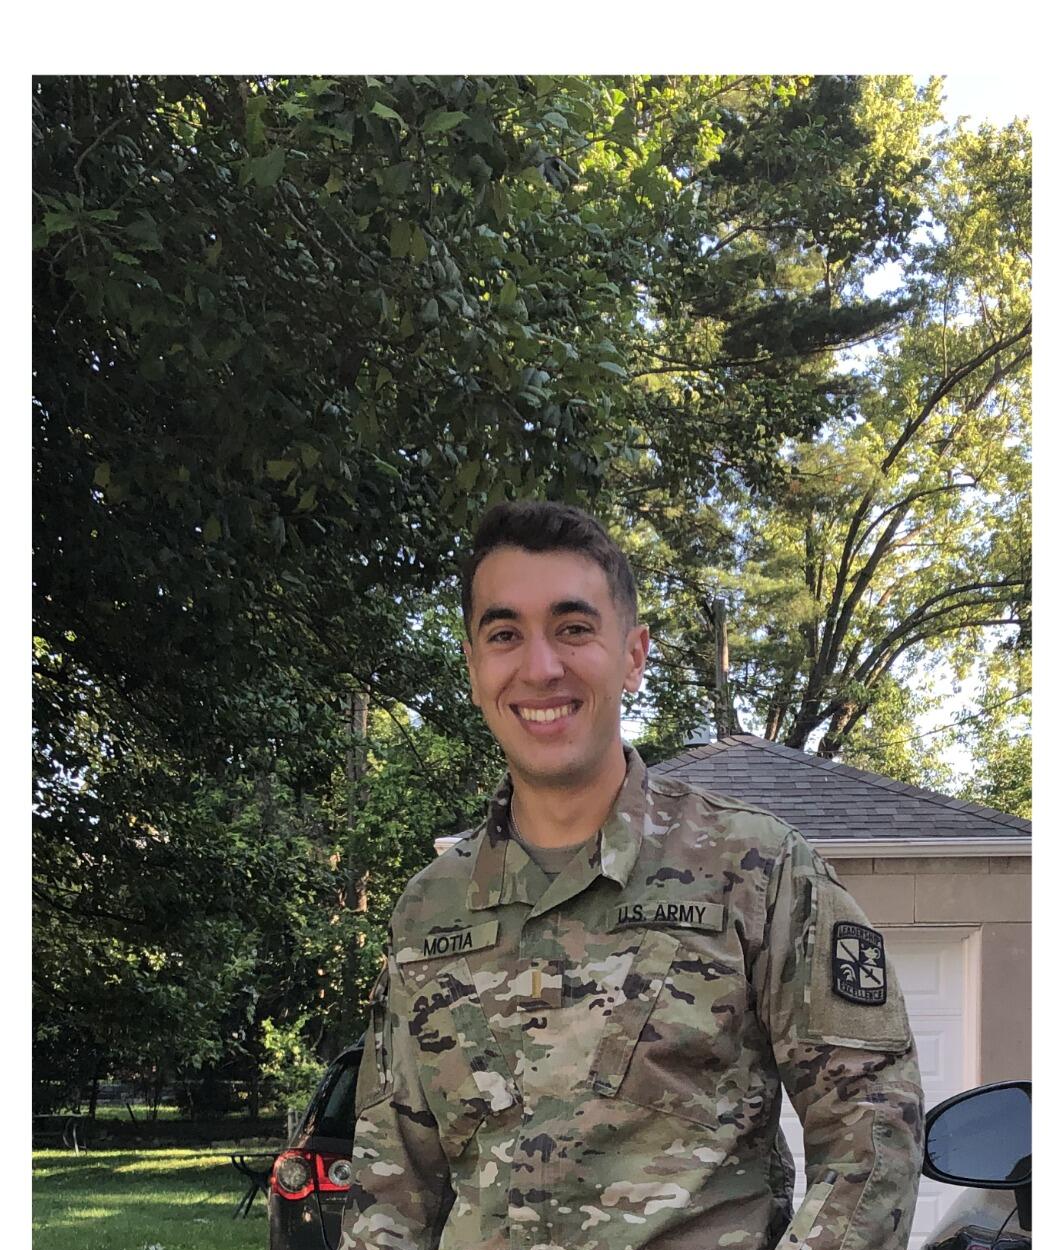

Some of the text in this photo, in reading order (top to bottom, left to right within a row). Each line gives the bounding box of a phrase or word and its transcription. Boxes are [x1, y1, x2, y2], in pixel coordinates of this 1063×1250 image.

[618, 903, 706, 924] U.S. ARMY
[423, 931, 473, 957] MOTIA
